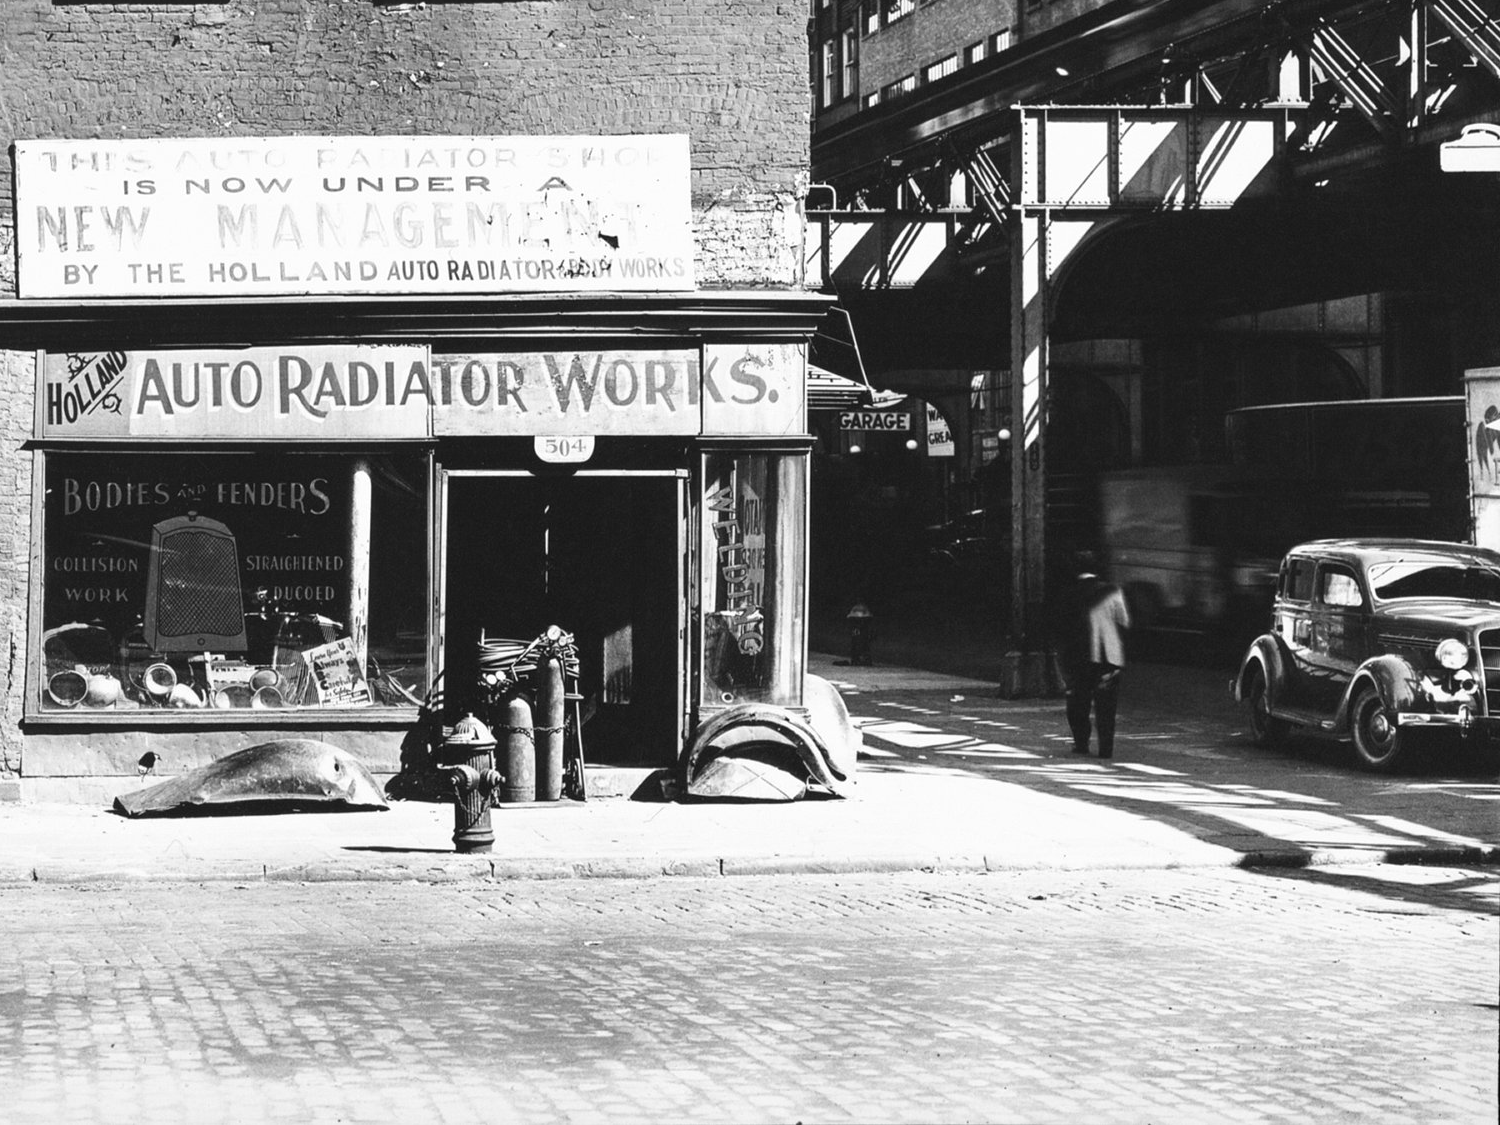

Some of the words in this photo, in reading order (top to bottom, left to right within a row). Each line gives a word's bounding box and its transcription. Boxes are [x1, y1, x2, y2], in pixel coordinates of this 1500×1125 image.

[41, 150, 152, 172] THIS
[176, 148, 286, 171] AUTO
[123, 179, 157, 195] IS
[185, 177, 293, 195] NOW
[322, 176, 492, 193] UNDER
[536, 176, 575, 193] A
[36, 204, 151, 253] NEW
[216, 200, 640, 251] MANAGEMENT
[63, 264, 100, 285] BY
[127, 262, 186, 284] THE
[208, 260, 379, 284] HOLLAND
[386, 259, 440, 281] AUTO
[446, 259, 556, 281] RADIATOR
[568, 257, 613, 280] BODY
[619, 257, 686, 279] WORKS
[47, 350, 128, 426] HOLLAND
[135, 358, 263, 416] AUTO
[277, 354, 530, 419] RADIATOR
[542, 354, 780, 413] WORKS.
[840, 412, 909, 430] GARAGE
[544, 438, 588, 457] 504
[63, 477, 171, 516] BODIES
[217, 477, 331, 515] FENDERS
[53, 557, 139, 573] COLLISION
[246, 555, 344, 572] STRAIGHTENED
[706, 485, 765, 657] WELDING
[65, 587, 129, 603] WORK
[274, 586, 335, 601] DUCOED
